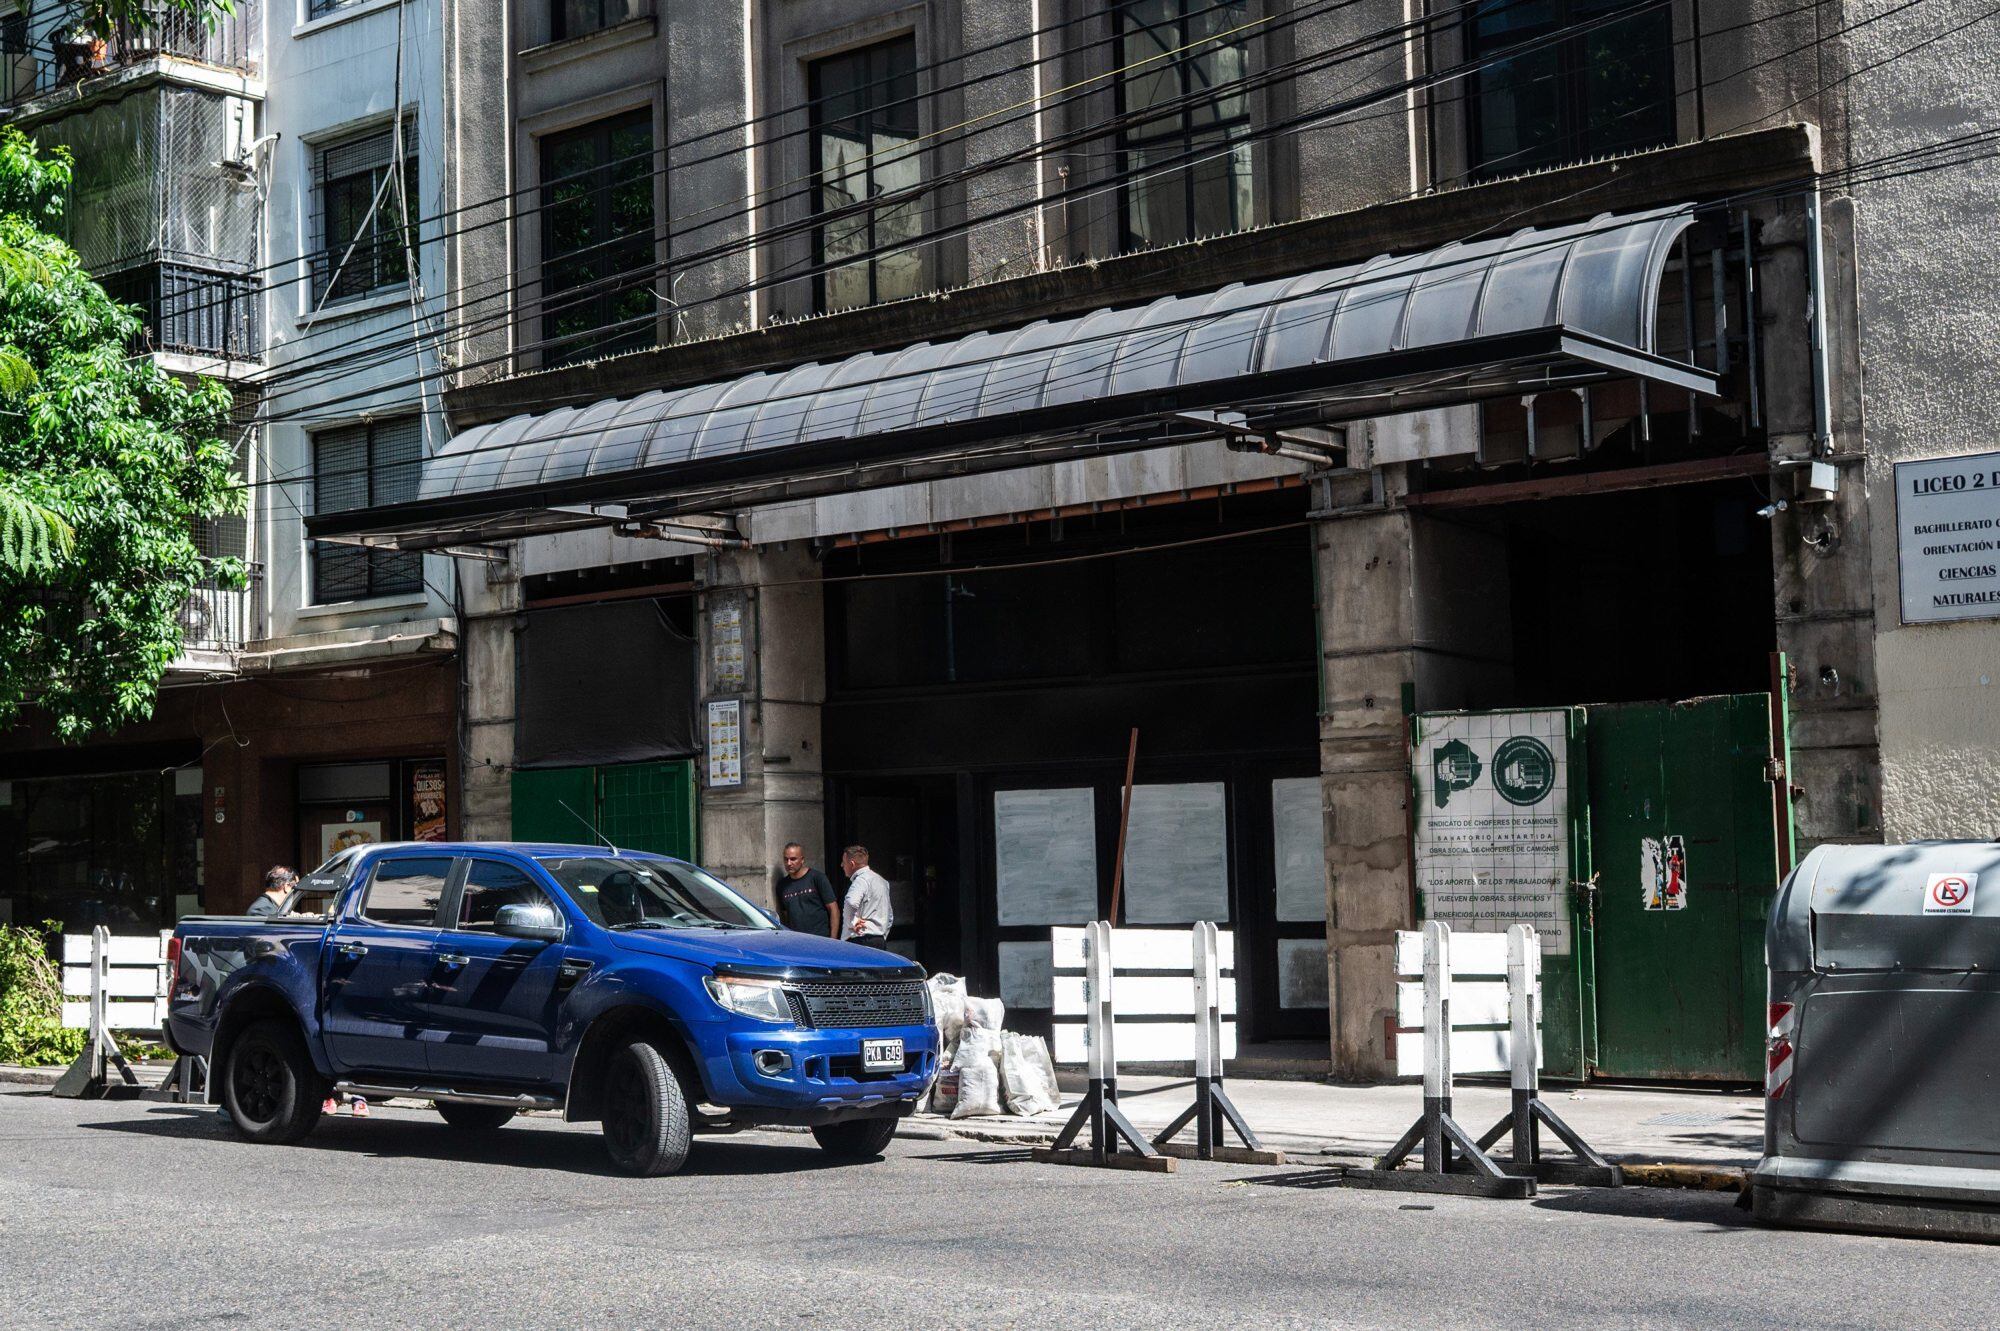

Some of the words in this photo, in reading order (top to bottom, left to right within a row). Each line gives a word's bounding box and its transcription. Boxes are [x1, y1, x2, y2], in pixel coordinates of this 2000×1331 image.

[1913, 475, 1966, 494] LICEO
[1973, 473, 1985, 488] 2
[1914, 519, 1992, 535] BACHILLERATO
[1923, 540, 1993, 555] ORIENTACIÓN
[1939, 564, 1996, 579] CIENCIAS
[1474, 819, 1511, 827] CHOFERES
[1523, 817, 1559, 825] CAMIONES
[1471, 846, 1480, 854] DE
[1481, 845, 1514, 853] CHOFERES
[1516, 845, 1525, 853] DE
[1526, 844, 1560, 852] CAMIONES
[865, 1046, 882, 1061] PKA
[885, 1045, 902, 1061] 649
